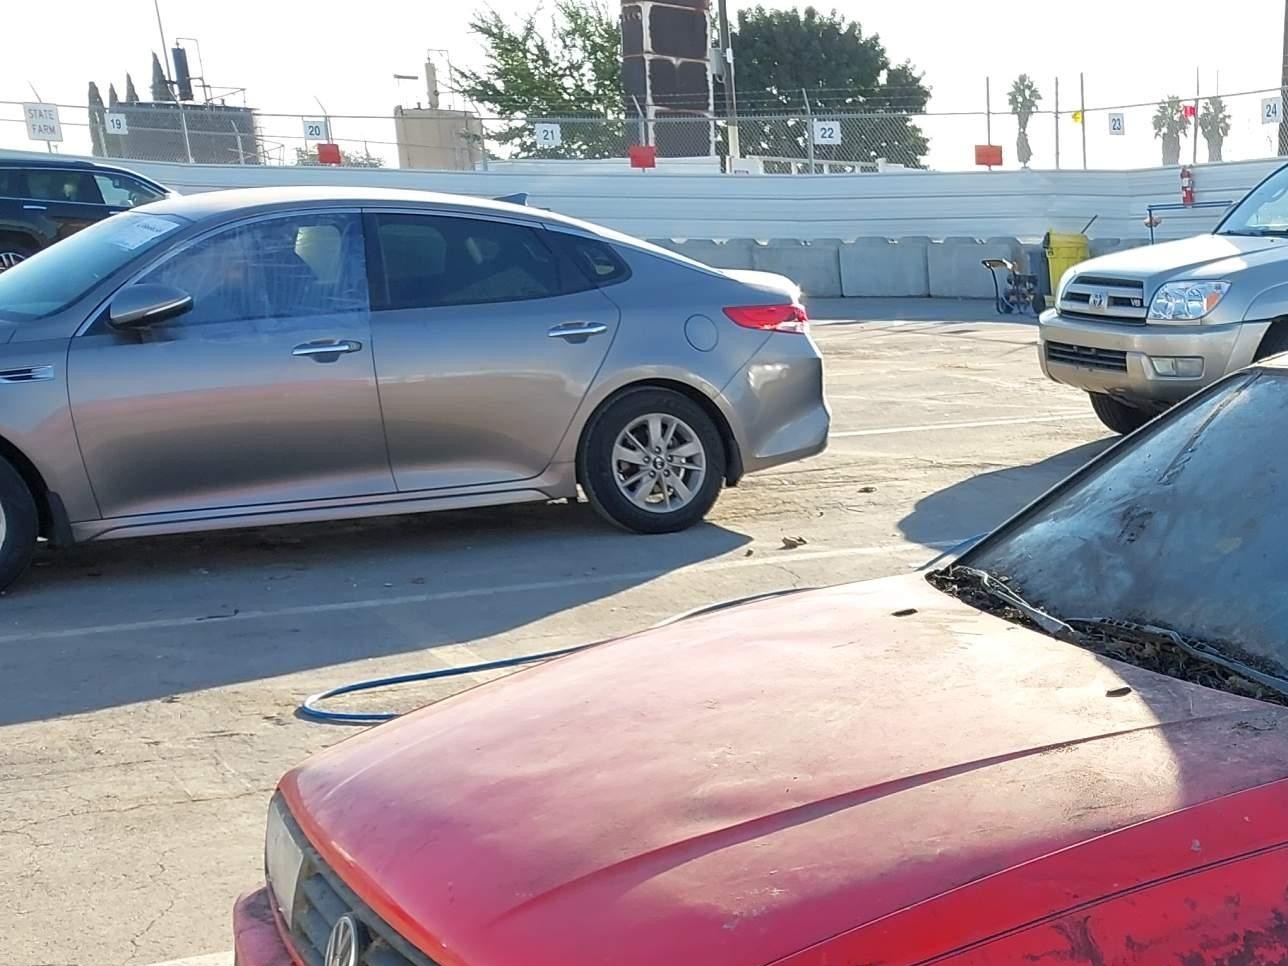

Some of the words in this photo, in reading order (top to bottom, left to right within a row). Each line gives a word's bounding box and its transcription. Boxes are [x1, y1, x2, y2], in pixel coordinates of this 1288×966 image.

[28, 108, 54, 121] STATE
[1265, 103, 1277, 117] 24
[32, 124, 56, 135] FARM
[110, 119, 121, 129] 19
[308, 125, 320, 136] 20
[542, 129, 554, 140] 21
[820, 127, 834, 139] 22
